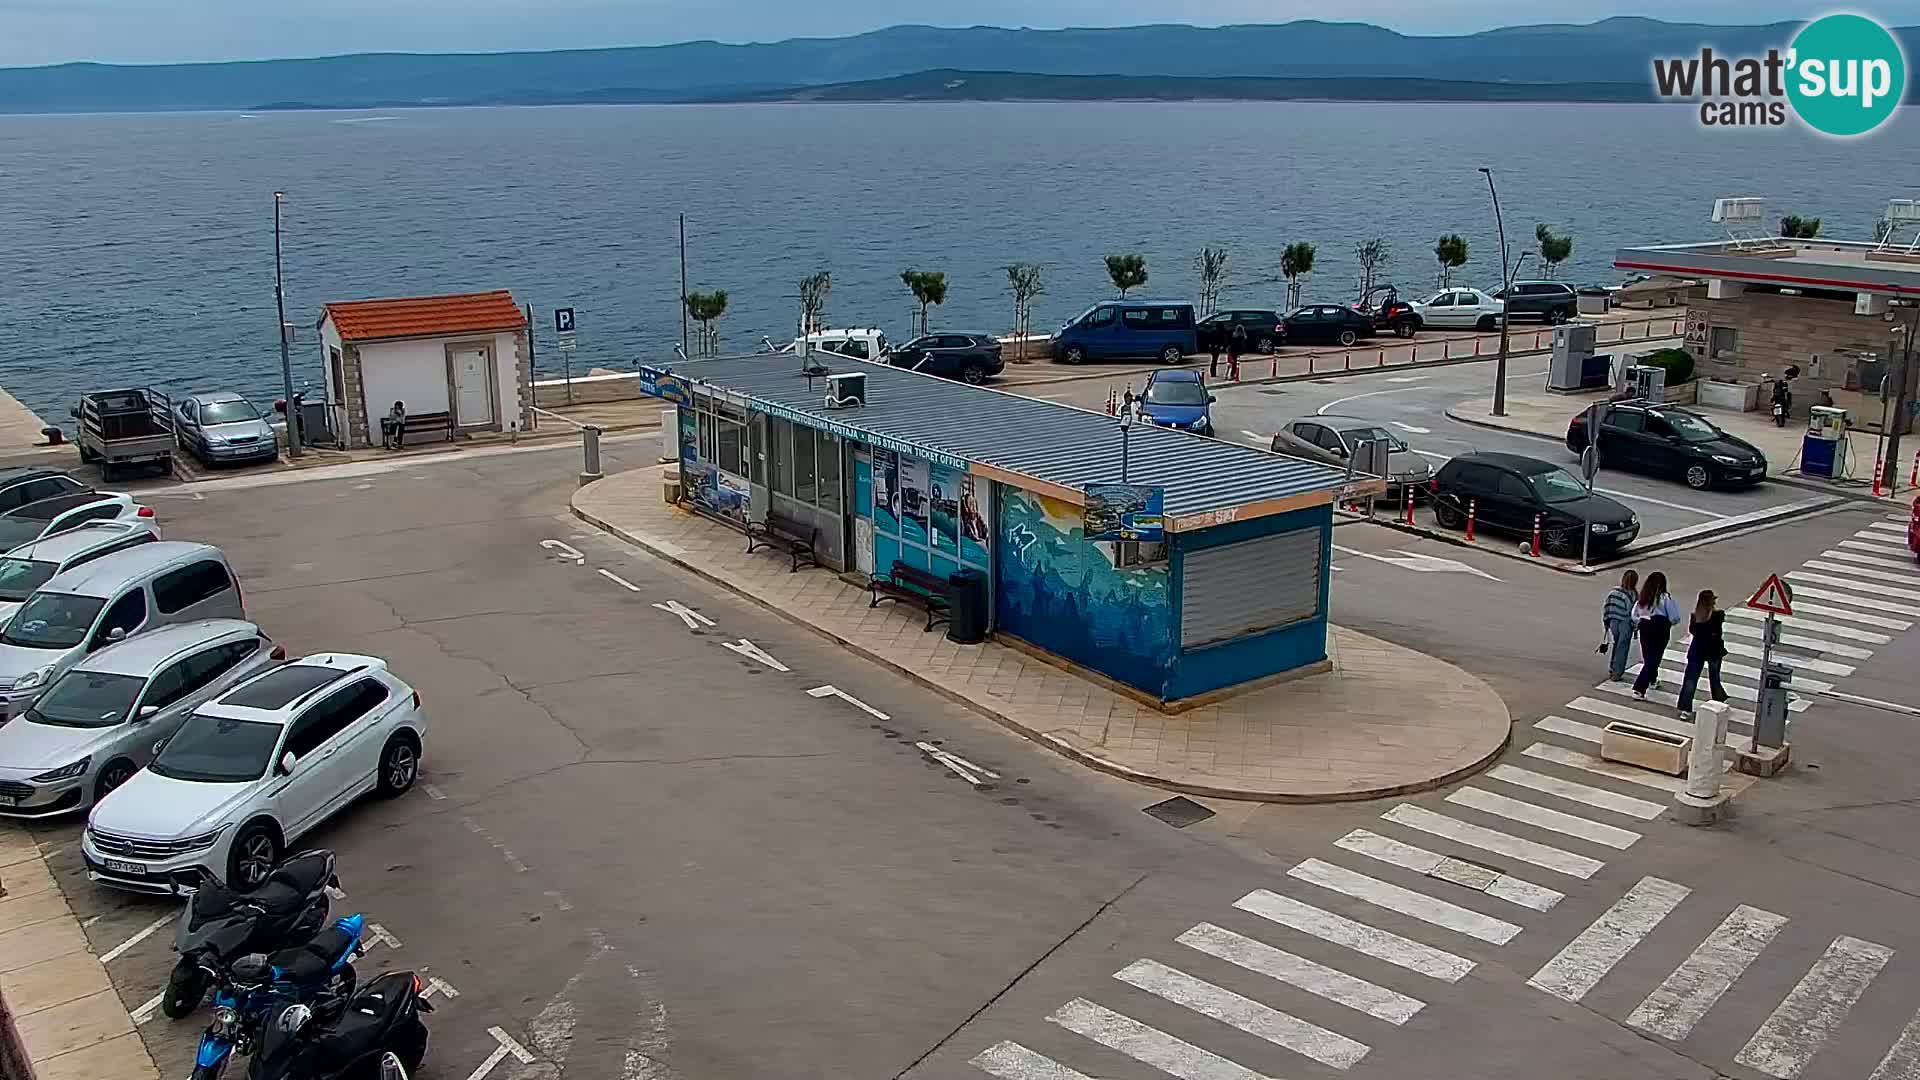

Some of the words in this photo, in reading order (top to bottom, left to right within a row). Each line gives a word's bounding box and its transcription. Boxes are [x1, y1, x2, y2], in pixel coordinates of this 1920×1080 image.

[559, 311, 570, 328] P
[830, 423, 858, 439] POSTAJA
[867, 434, 881, 446] BUS
[882, 438, 912, 454] STATION
[914, 447, 939, 464] TICKET
[940, 454, 966, 469] OFFICE
